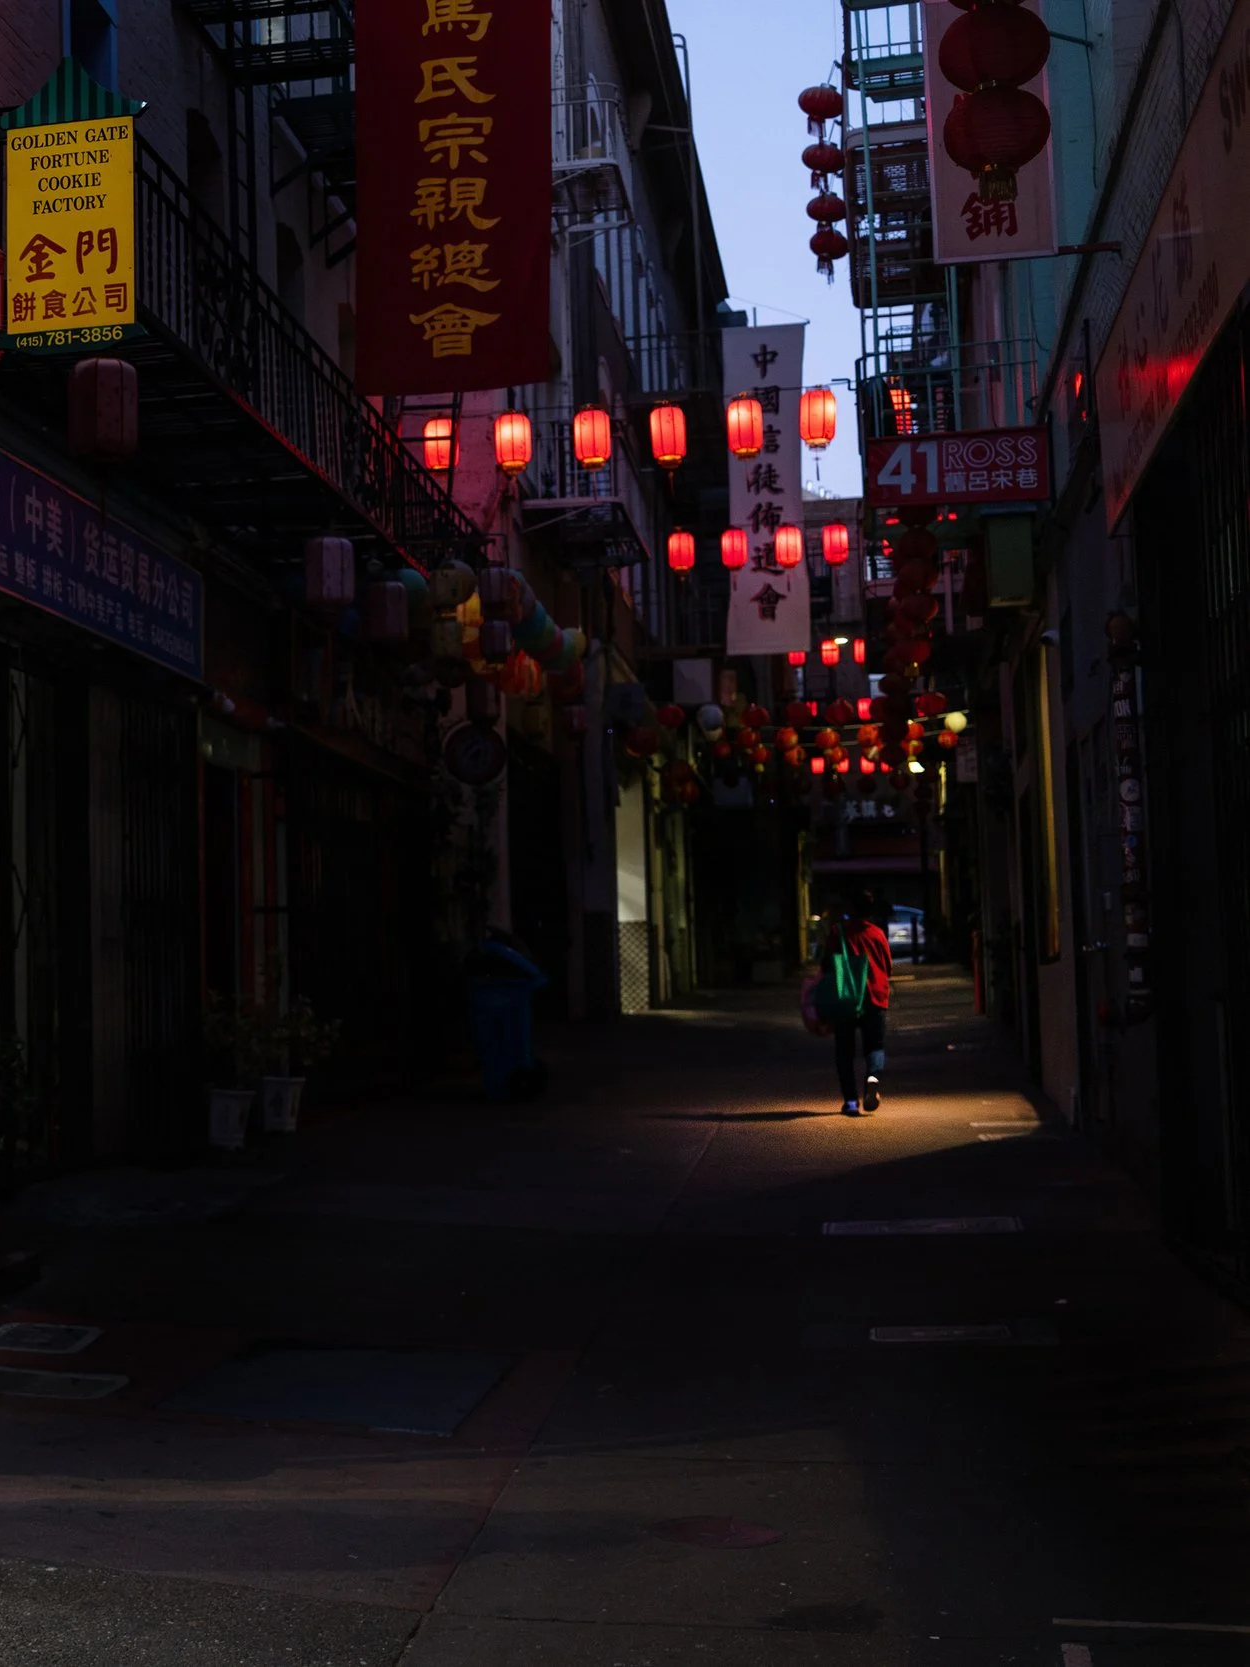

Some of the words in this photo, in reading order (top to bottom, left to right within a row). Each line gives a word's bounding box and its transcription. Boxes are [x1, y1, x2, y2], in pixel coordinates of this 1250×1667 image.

[11, 130, 78, 151] GOLDEN
[85, 125, 129, 143] GATE
[30, 149, 109, 171] FORTUNE
[38, 172, 101, 192] COOKIE
[33, 194, 107, 215] FACTORY
[19, 227, 118, 283] 金門
[12, 283, 127, 323] 餅食公司
[16, 335, 43, 348] (415)
[46, 326, 123, 346] 781-3856
[877, 440, 939, 495] 41
[942, 435, 1038, 470] ROSS
